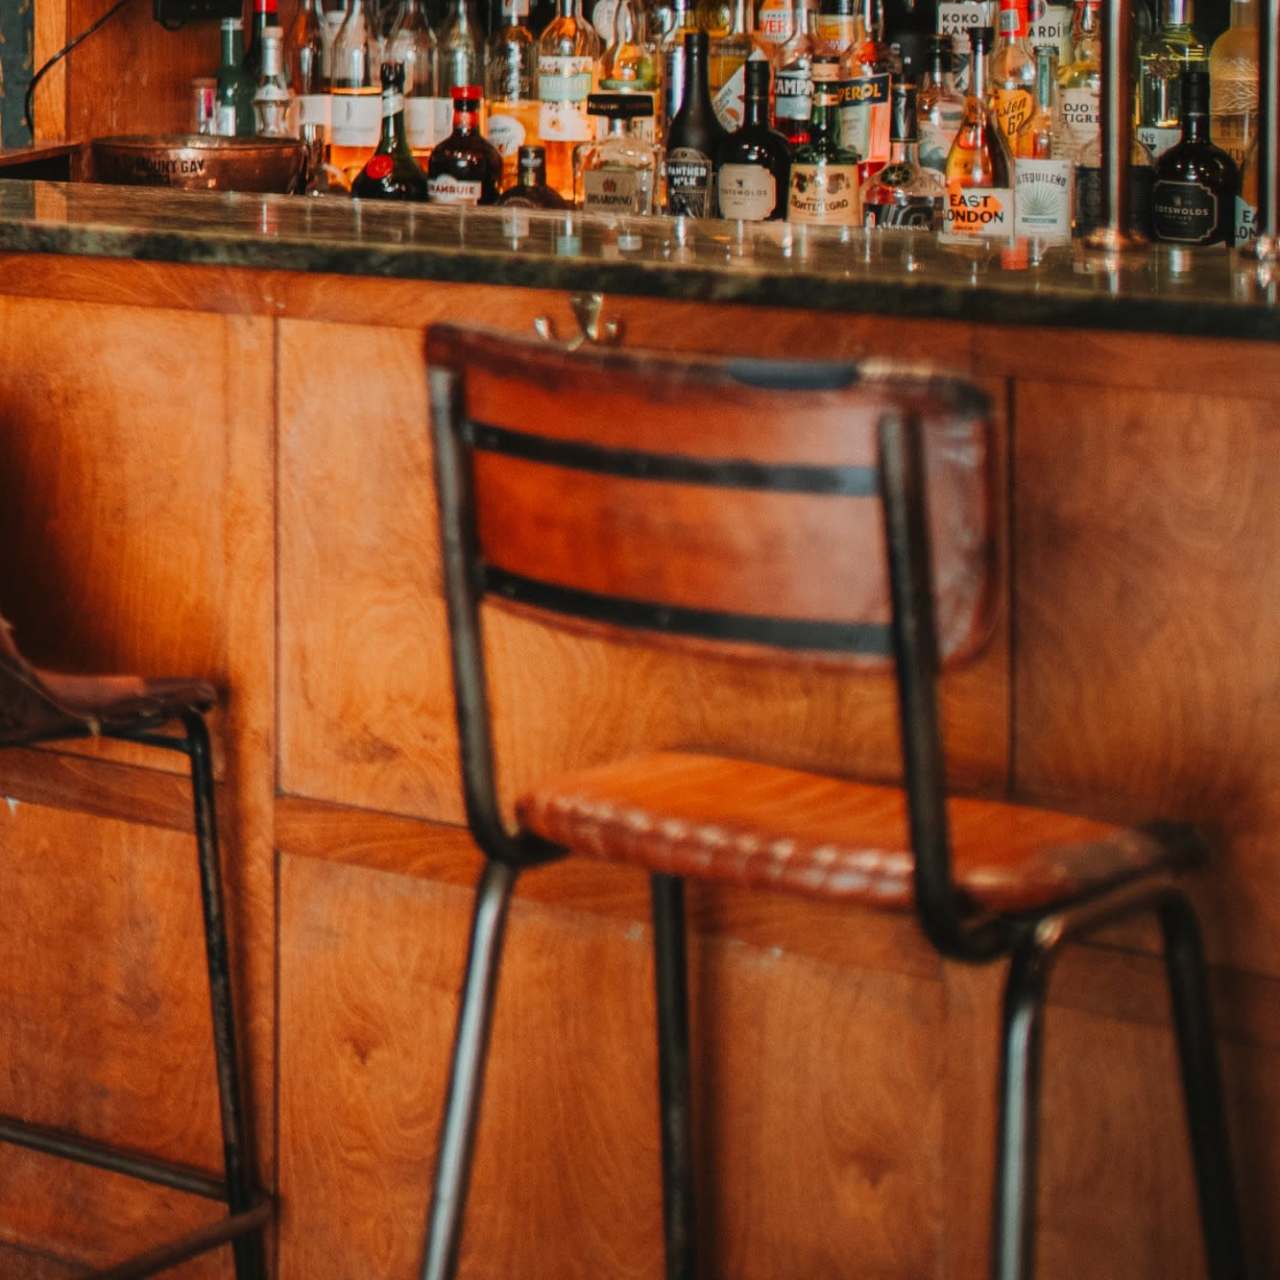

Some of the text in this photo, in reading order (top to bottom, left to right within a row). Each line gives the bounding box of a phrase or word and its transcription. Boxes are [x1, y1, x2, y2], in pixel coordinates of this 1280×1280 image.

[942, 13, 980, 24] KOKO
[838, 83, 882, 100] PEROL
[1063, 103, 1089, 113] OJO
[180, 159, 205, 174] GAY
[428, 183, 475, 195] RAMBUIE
[949, 194, 991, 208] EAST
[946, 209, 1005, 224] ONDON
